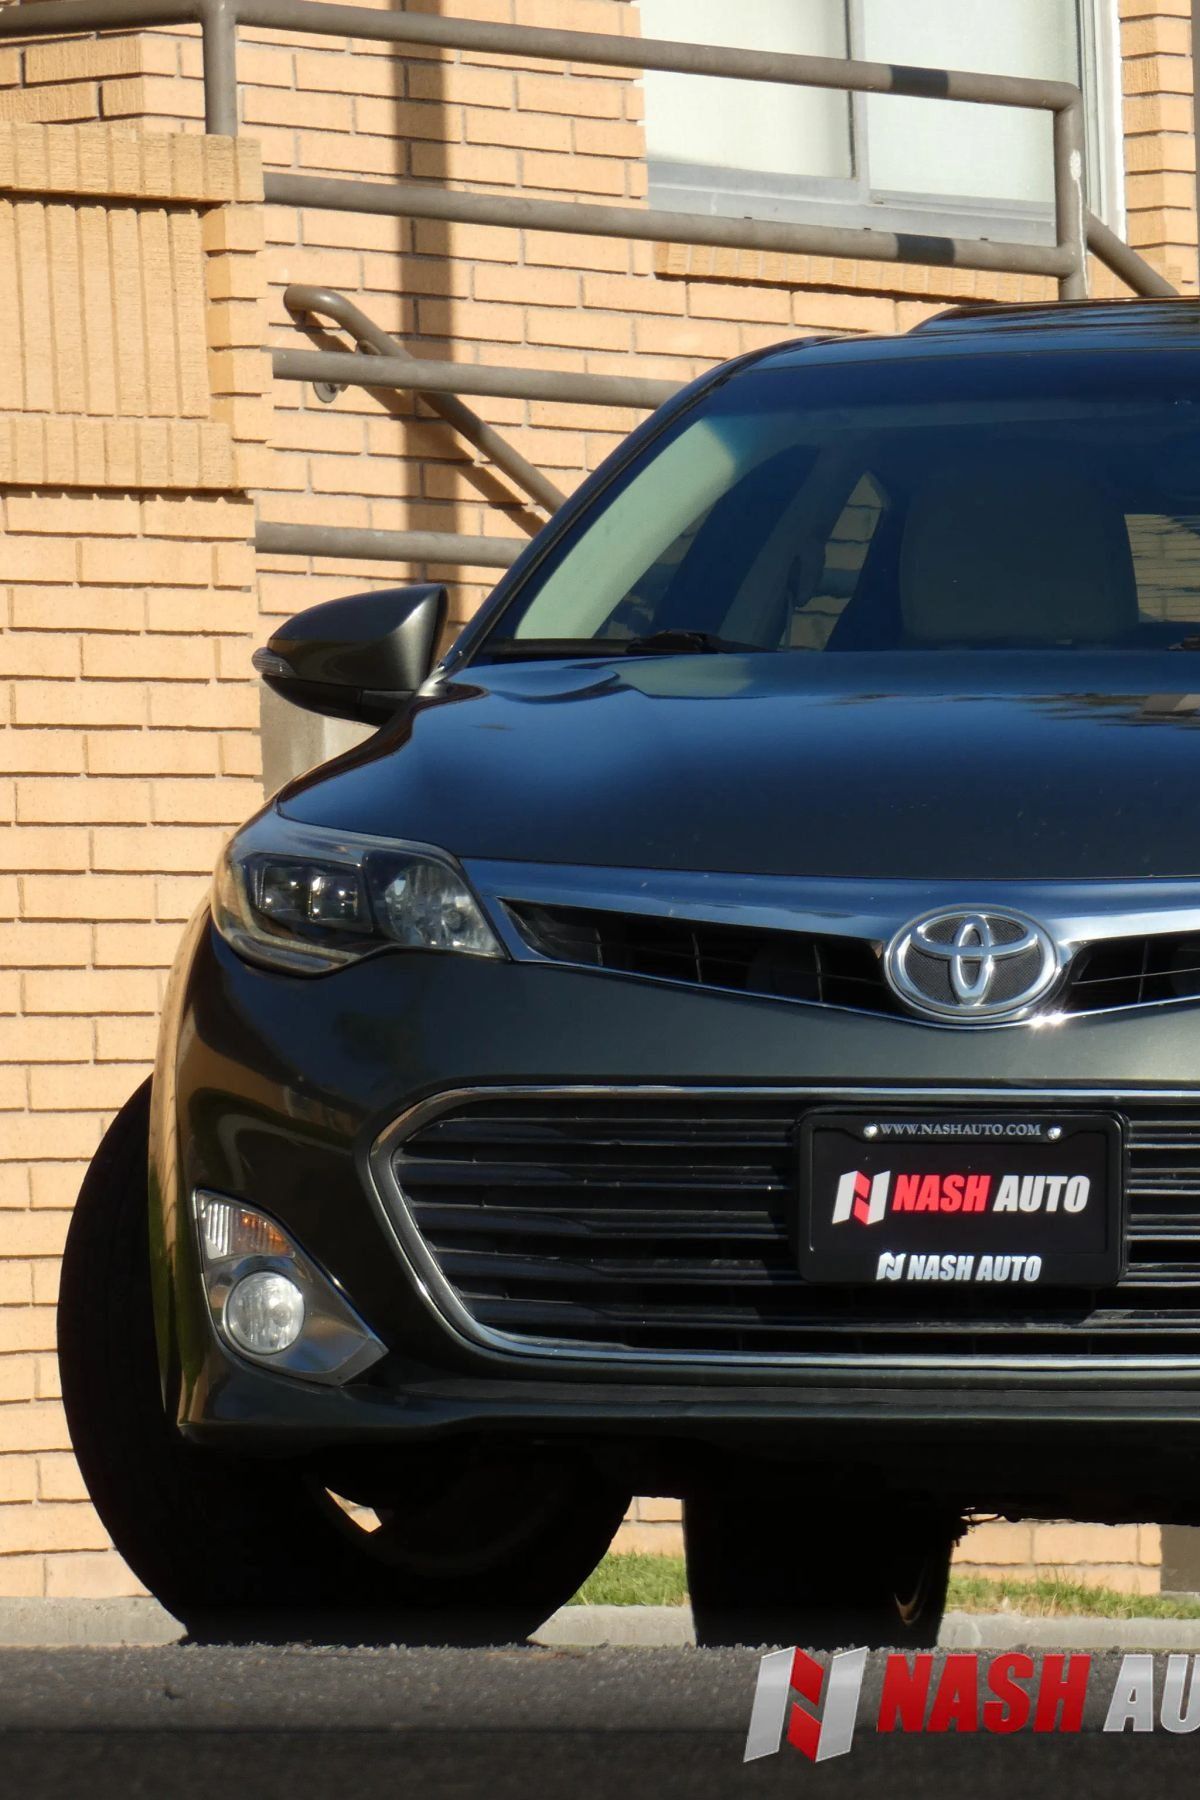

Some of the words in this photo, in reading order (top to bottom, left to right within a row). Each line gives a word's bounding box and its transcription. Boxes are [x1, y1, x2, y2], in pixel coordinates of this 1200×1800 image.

[880, 1123, 1042, 1136] WWW.NASHAUTO.COM
[892, 1174, 991, 1212] NASH
[993, 1174, 1091, 1212] AUTO
[906, 1254, 975, 1281] NASH
[975, 1255, 1042, 1282] AUTO
